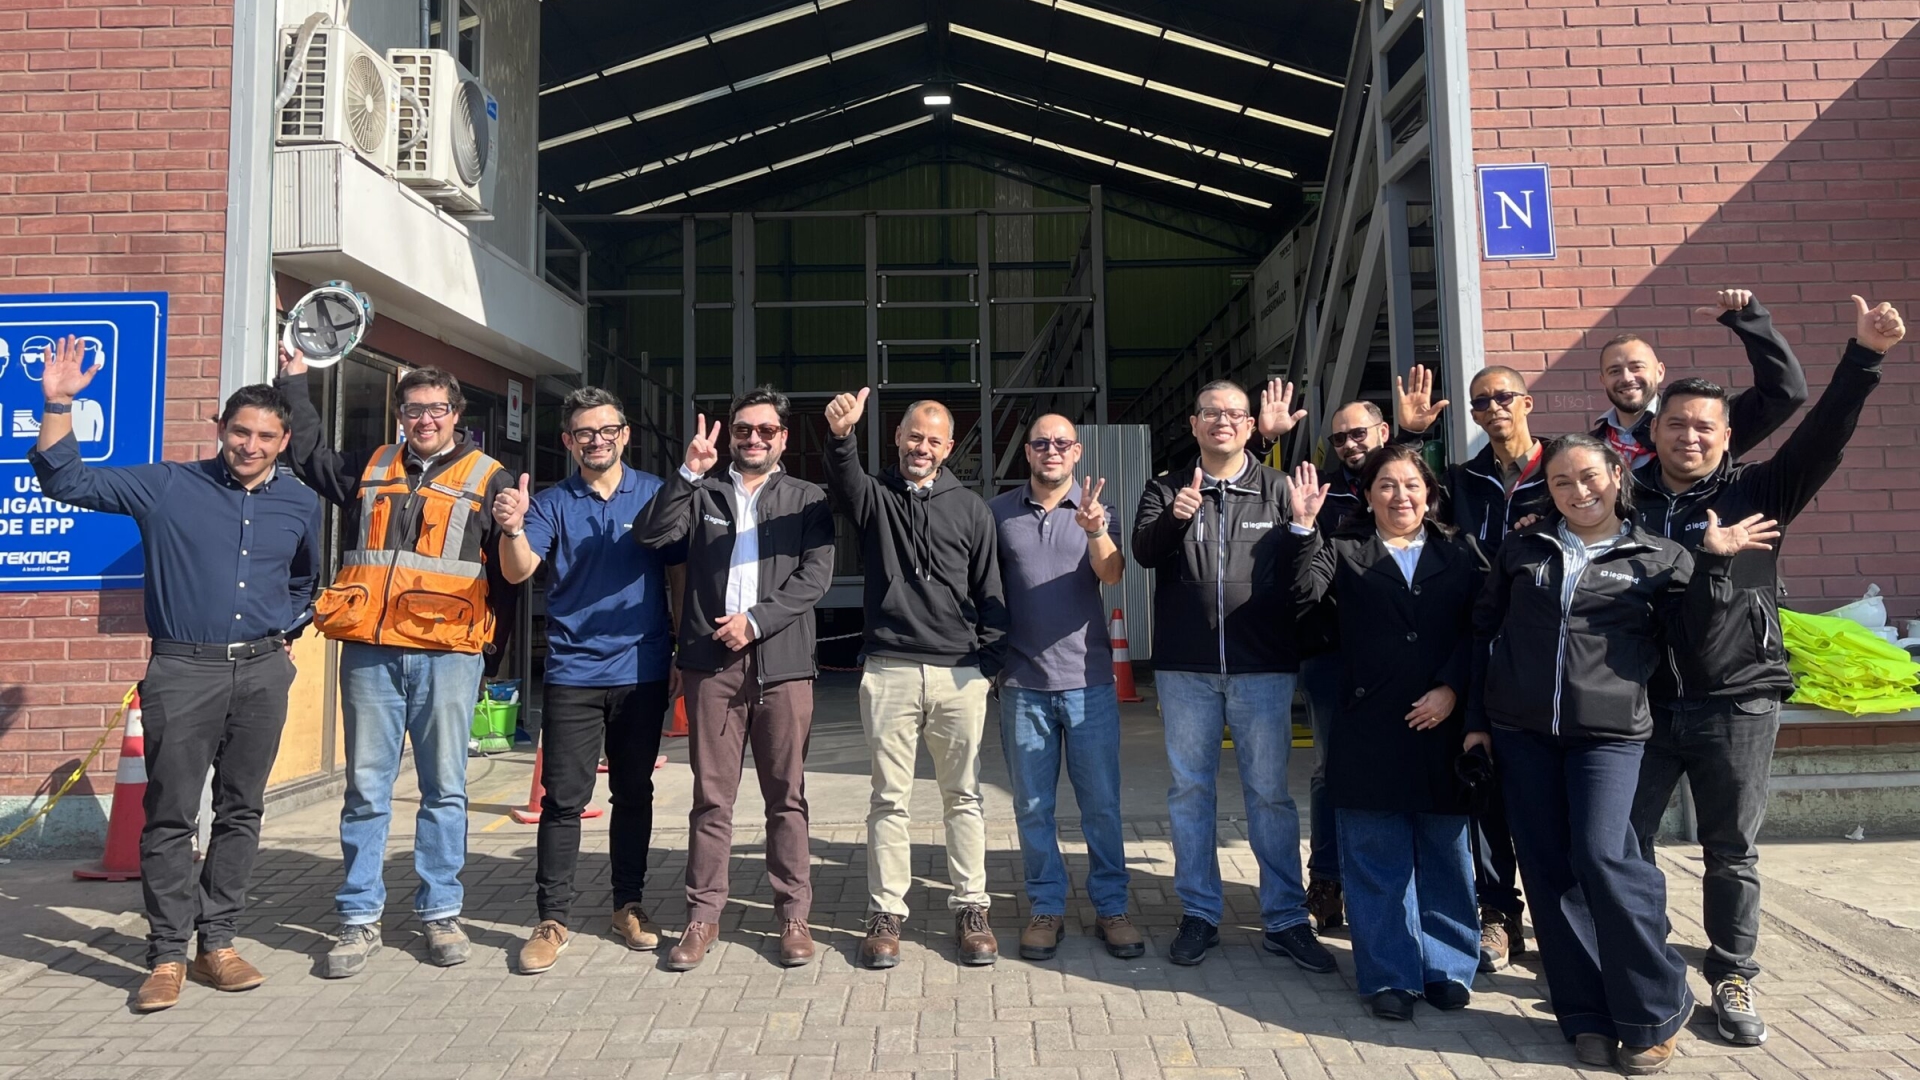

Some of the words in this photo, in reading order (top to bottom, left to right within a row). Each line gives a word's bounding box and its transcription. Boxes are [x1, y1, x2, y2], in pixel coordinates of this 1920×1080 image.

[1493, 190, 1534, 229] N
[1266, 280, 1280, 300] TALLER
[1260, 289, 1287, 322] DIMENSIONADO
[14, 476, 42, 493] US
[30, 517, 75, 535] EPP
[1249, 521, 1273, 530] legrand
[1691, 517, 1723, 530] legrd
[0, 550, 71, 565] TEKNICA
[1609, 570, 1640, 585] legrand
